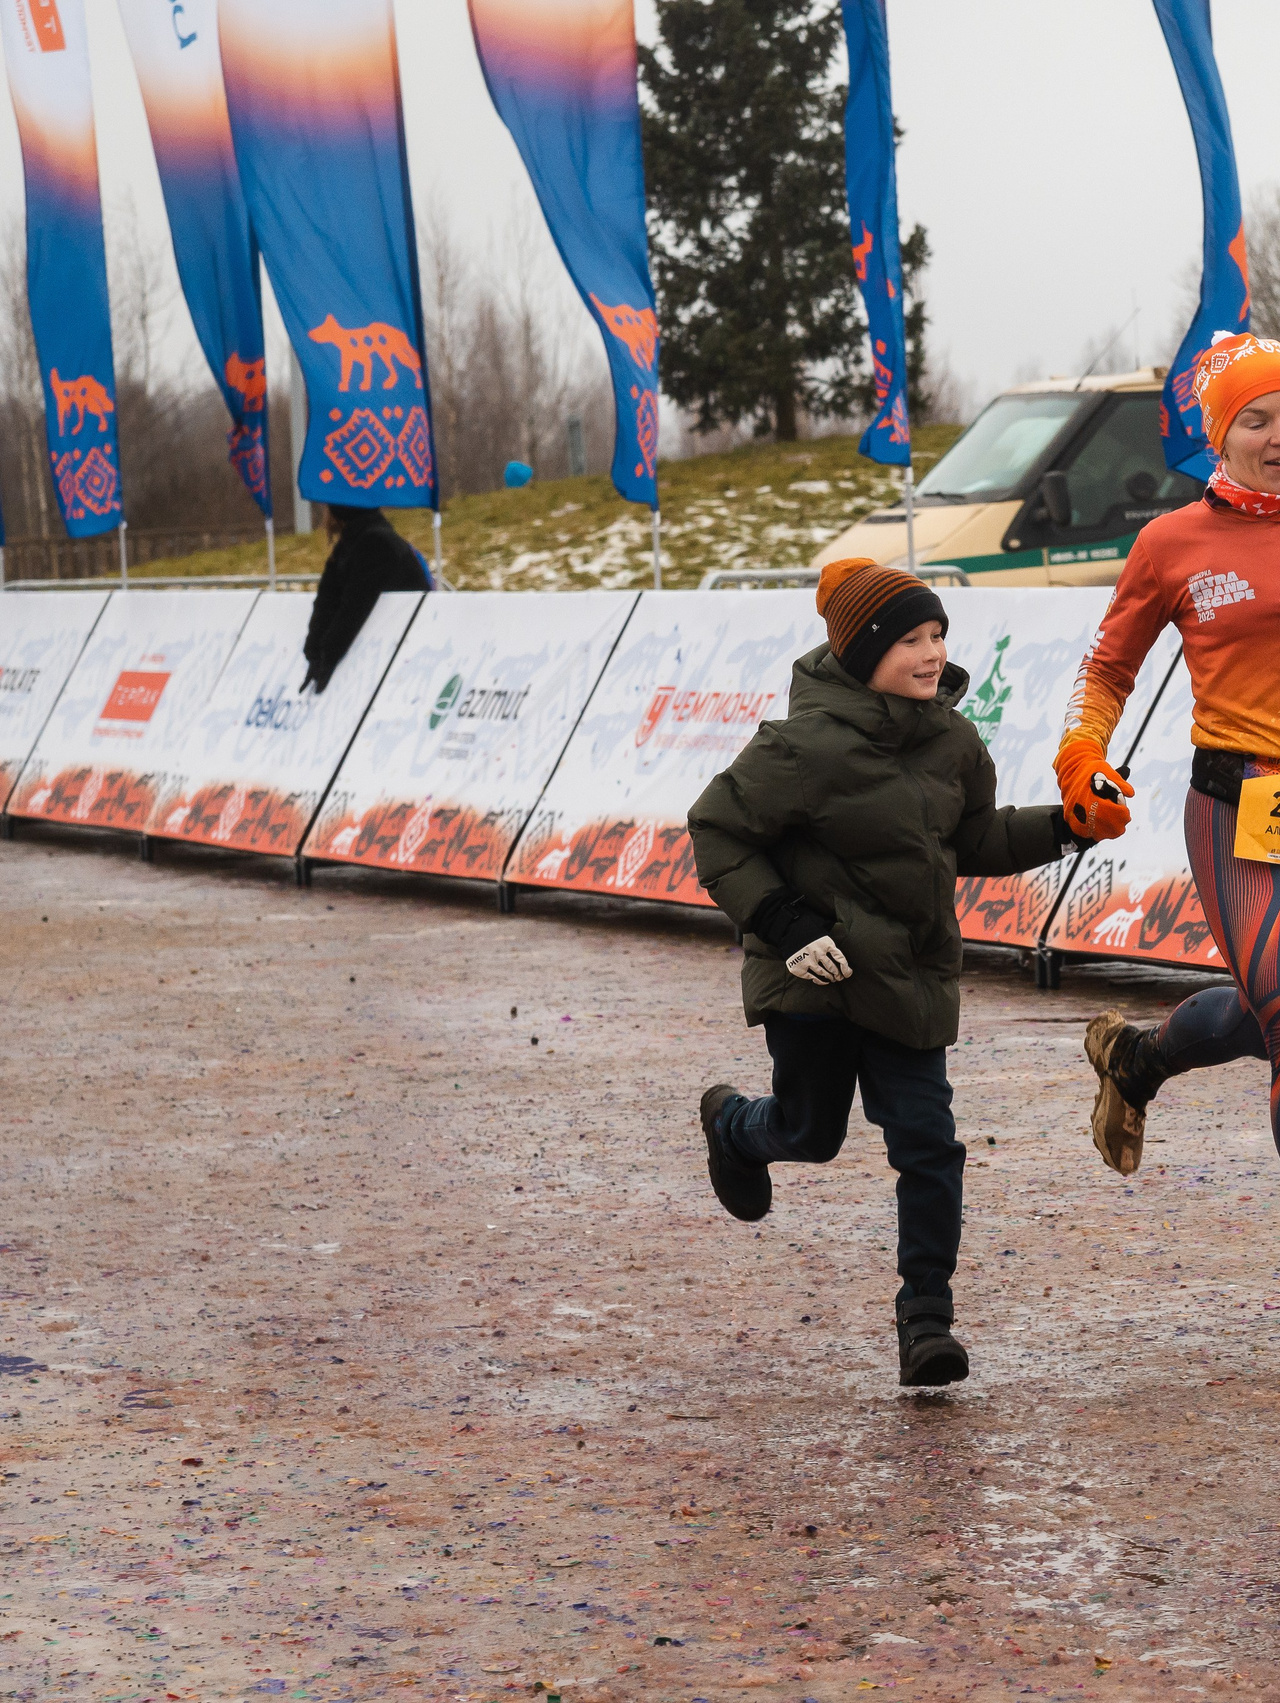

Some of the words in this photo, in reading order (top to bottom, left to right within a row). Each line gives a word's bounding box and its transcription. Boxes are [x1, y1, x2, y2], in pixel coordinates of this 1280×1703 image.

[1188, 571, 1239, 594] ULTRA
[1192, 580, 1249, 603] GRAND
[1194, 589, 1256, 612] ESCAPE
[1197, 609, 1216, 624] 2025
[458, 678, 532, 720] azimut
[672, 691, 776, 724] ЧЕМПИОНАТ
